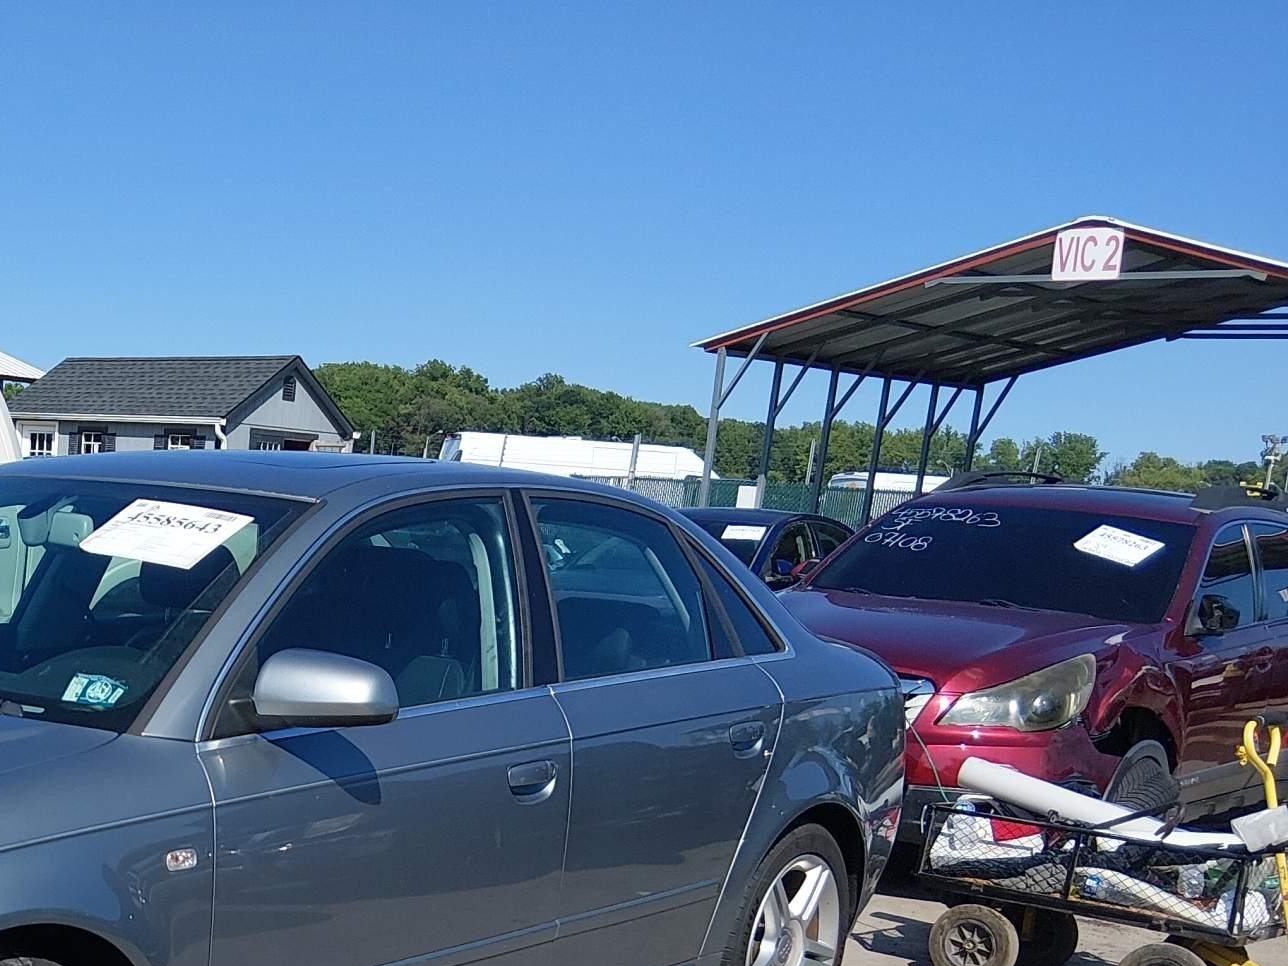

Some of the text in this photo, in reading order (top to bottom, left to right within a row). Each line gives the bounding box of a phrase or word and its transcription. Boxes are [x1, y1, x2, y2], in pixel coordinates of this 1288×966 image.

[1058, 235, 1120, 273] VIC 2
[127, 511, 223, 534] 45585643
[864, 531, 933, 551] 07/08
